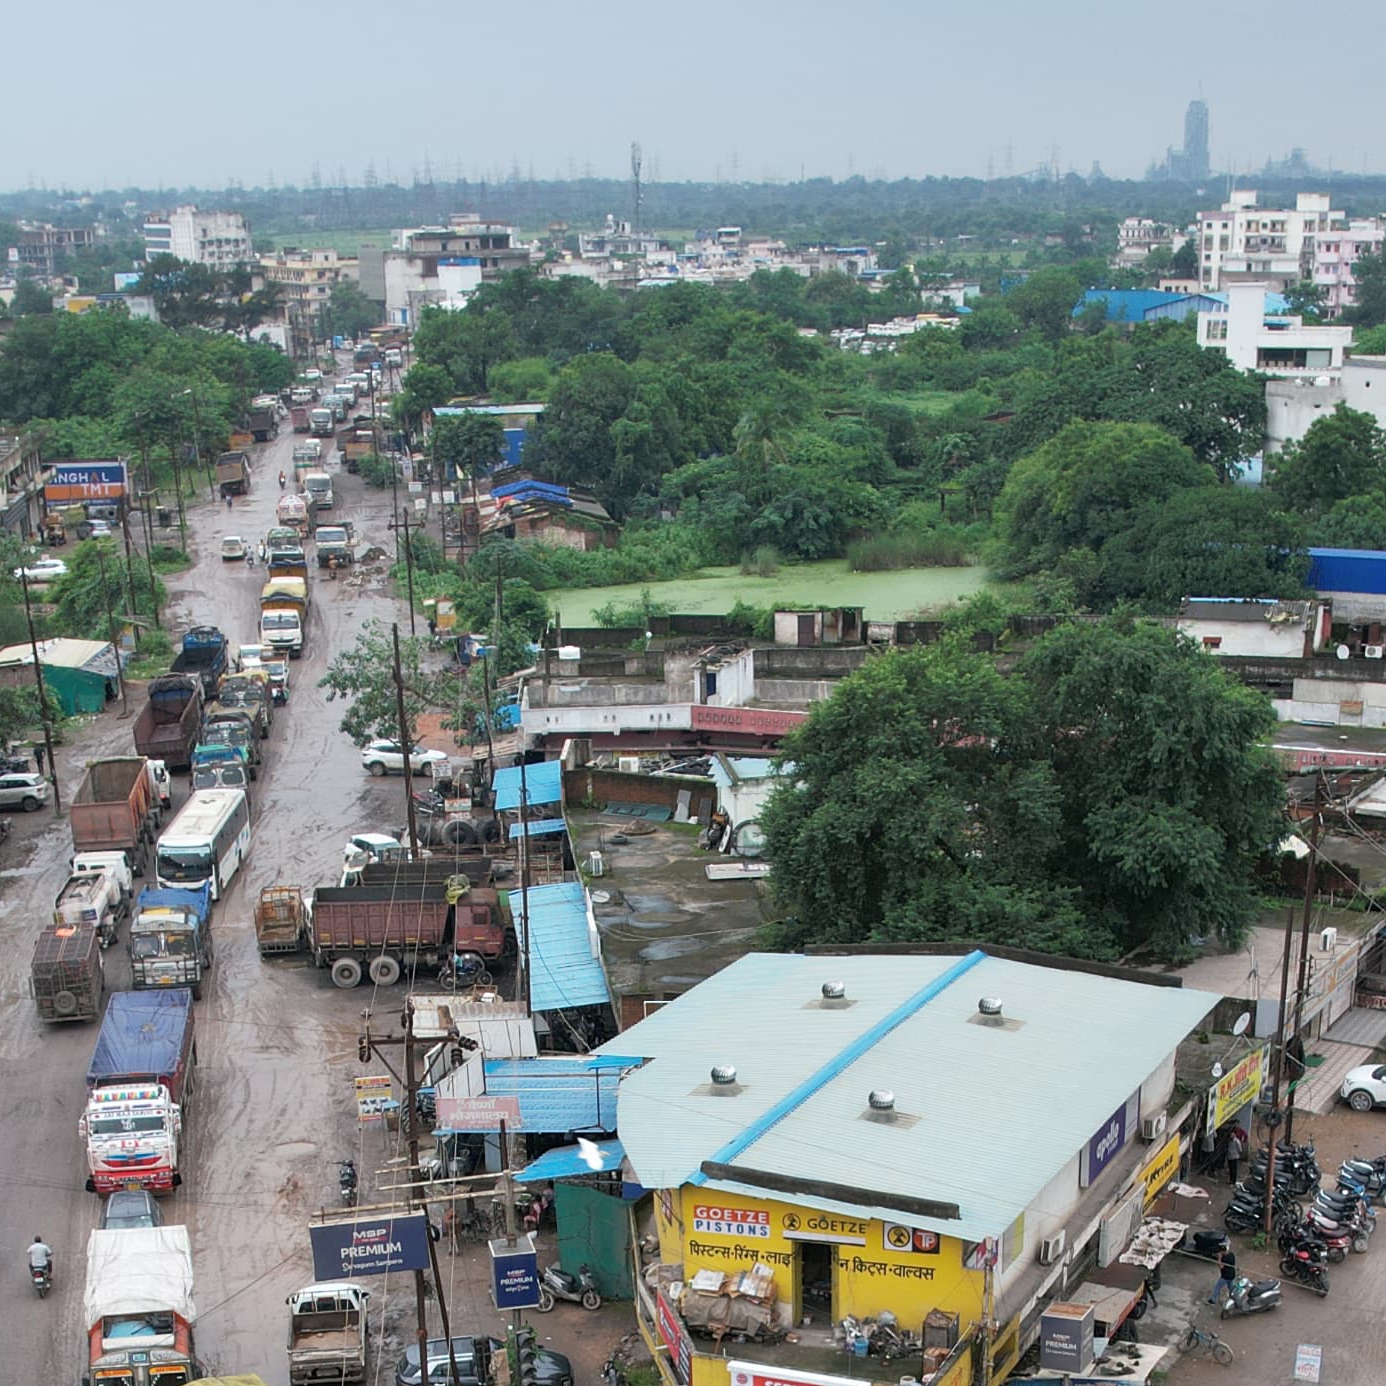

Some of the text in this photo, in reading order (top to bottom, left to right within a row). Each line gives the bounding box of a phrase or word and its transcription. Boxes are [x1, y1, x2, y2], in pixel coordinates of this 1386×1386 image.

[49, 472, 110, 484] INGHAL
[81, 483, 110, 496] TMT
[695, 1206, 769, 1224] GOETZE
[695, 1219, 768, 1237] PISTONS
[806, 1217, 867, 1234] GOETZE
[353, 1228, 387, 1239] MSP
[340, 1241, 402, 1259] PREMIUM
[500, 1276, 533, 1286] PREMIUM
[1045, 1340, 1077, 1350] PREMIUM
